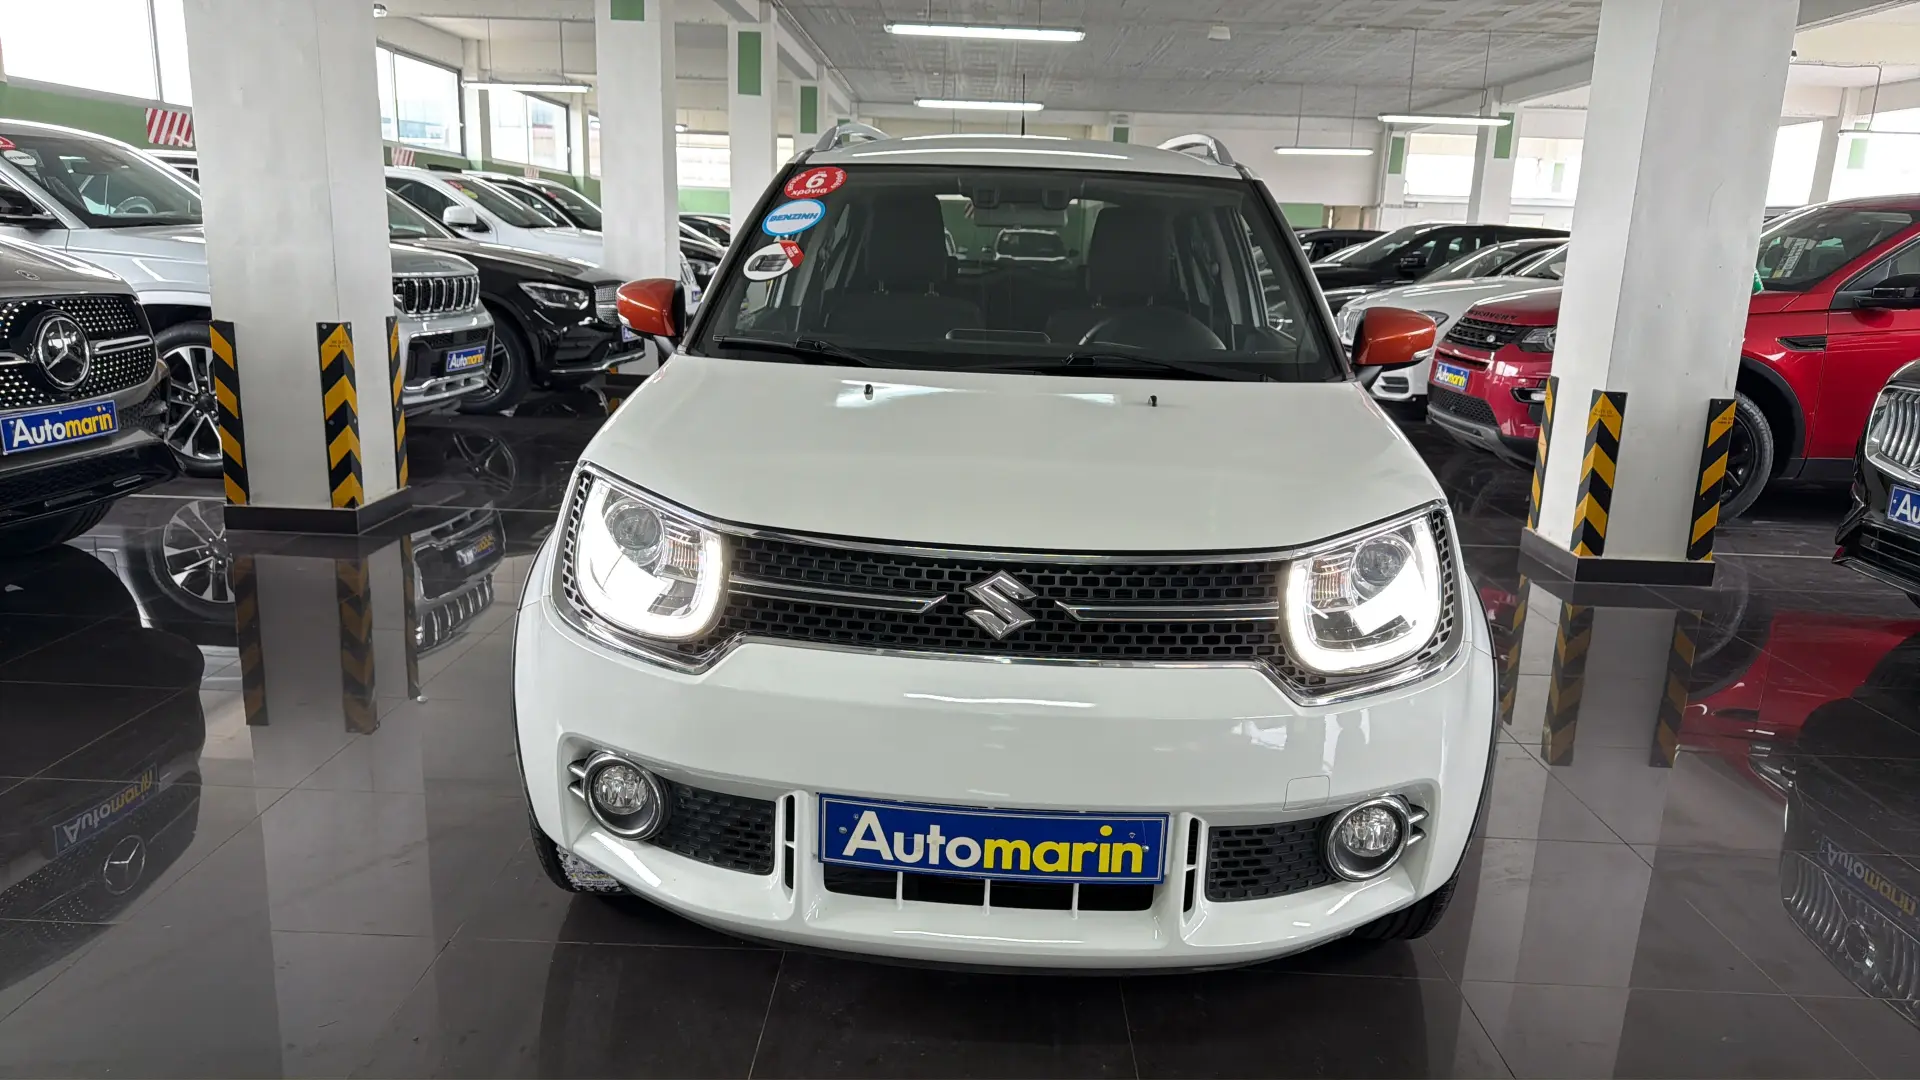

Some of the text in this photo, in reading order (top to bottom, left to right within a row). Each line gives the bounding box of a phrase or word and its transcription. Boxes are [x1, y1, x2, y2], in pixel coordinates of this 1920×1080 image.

[806, 174, 828, 188] 6
[12, 405, 113, 448] Automarin
[842, 810, 1143, 874] Automarin
